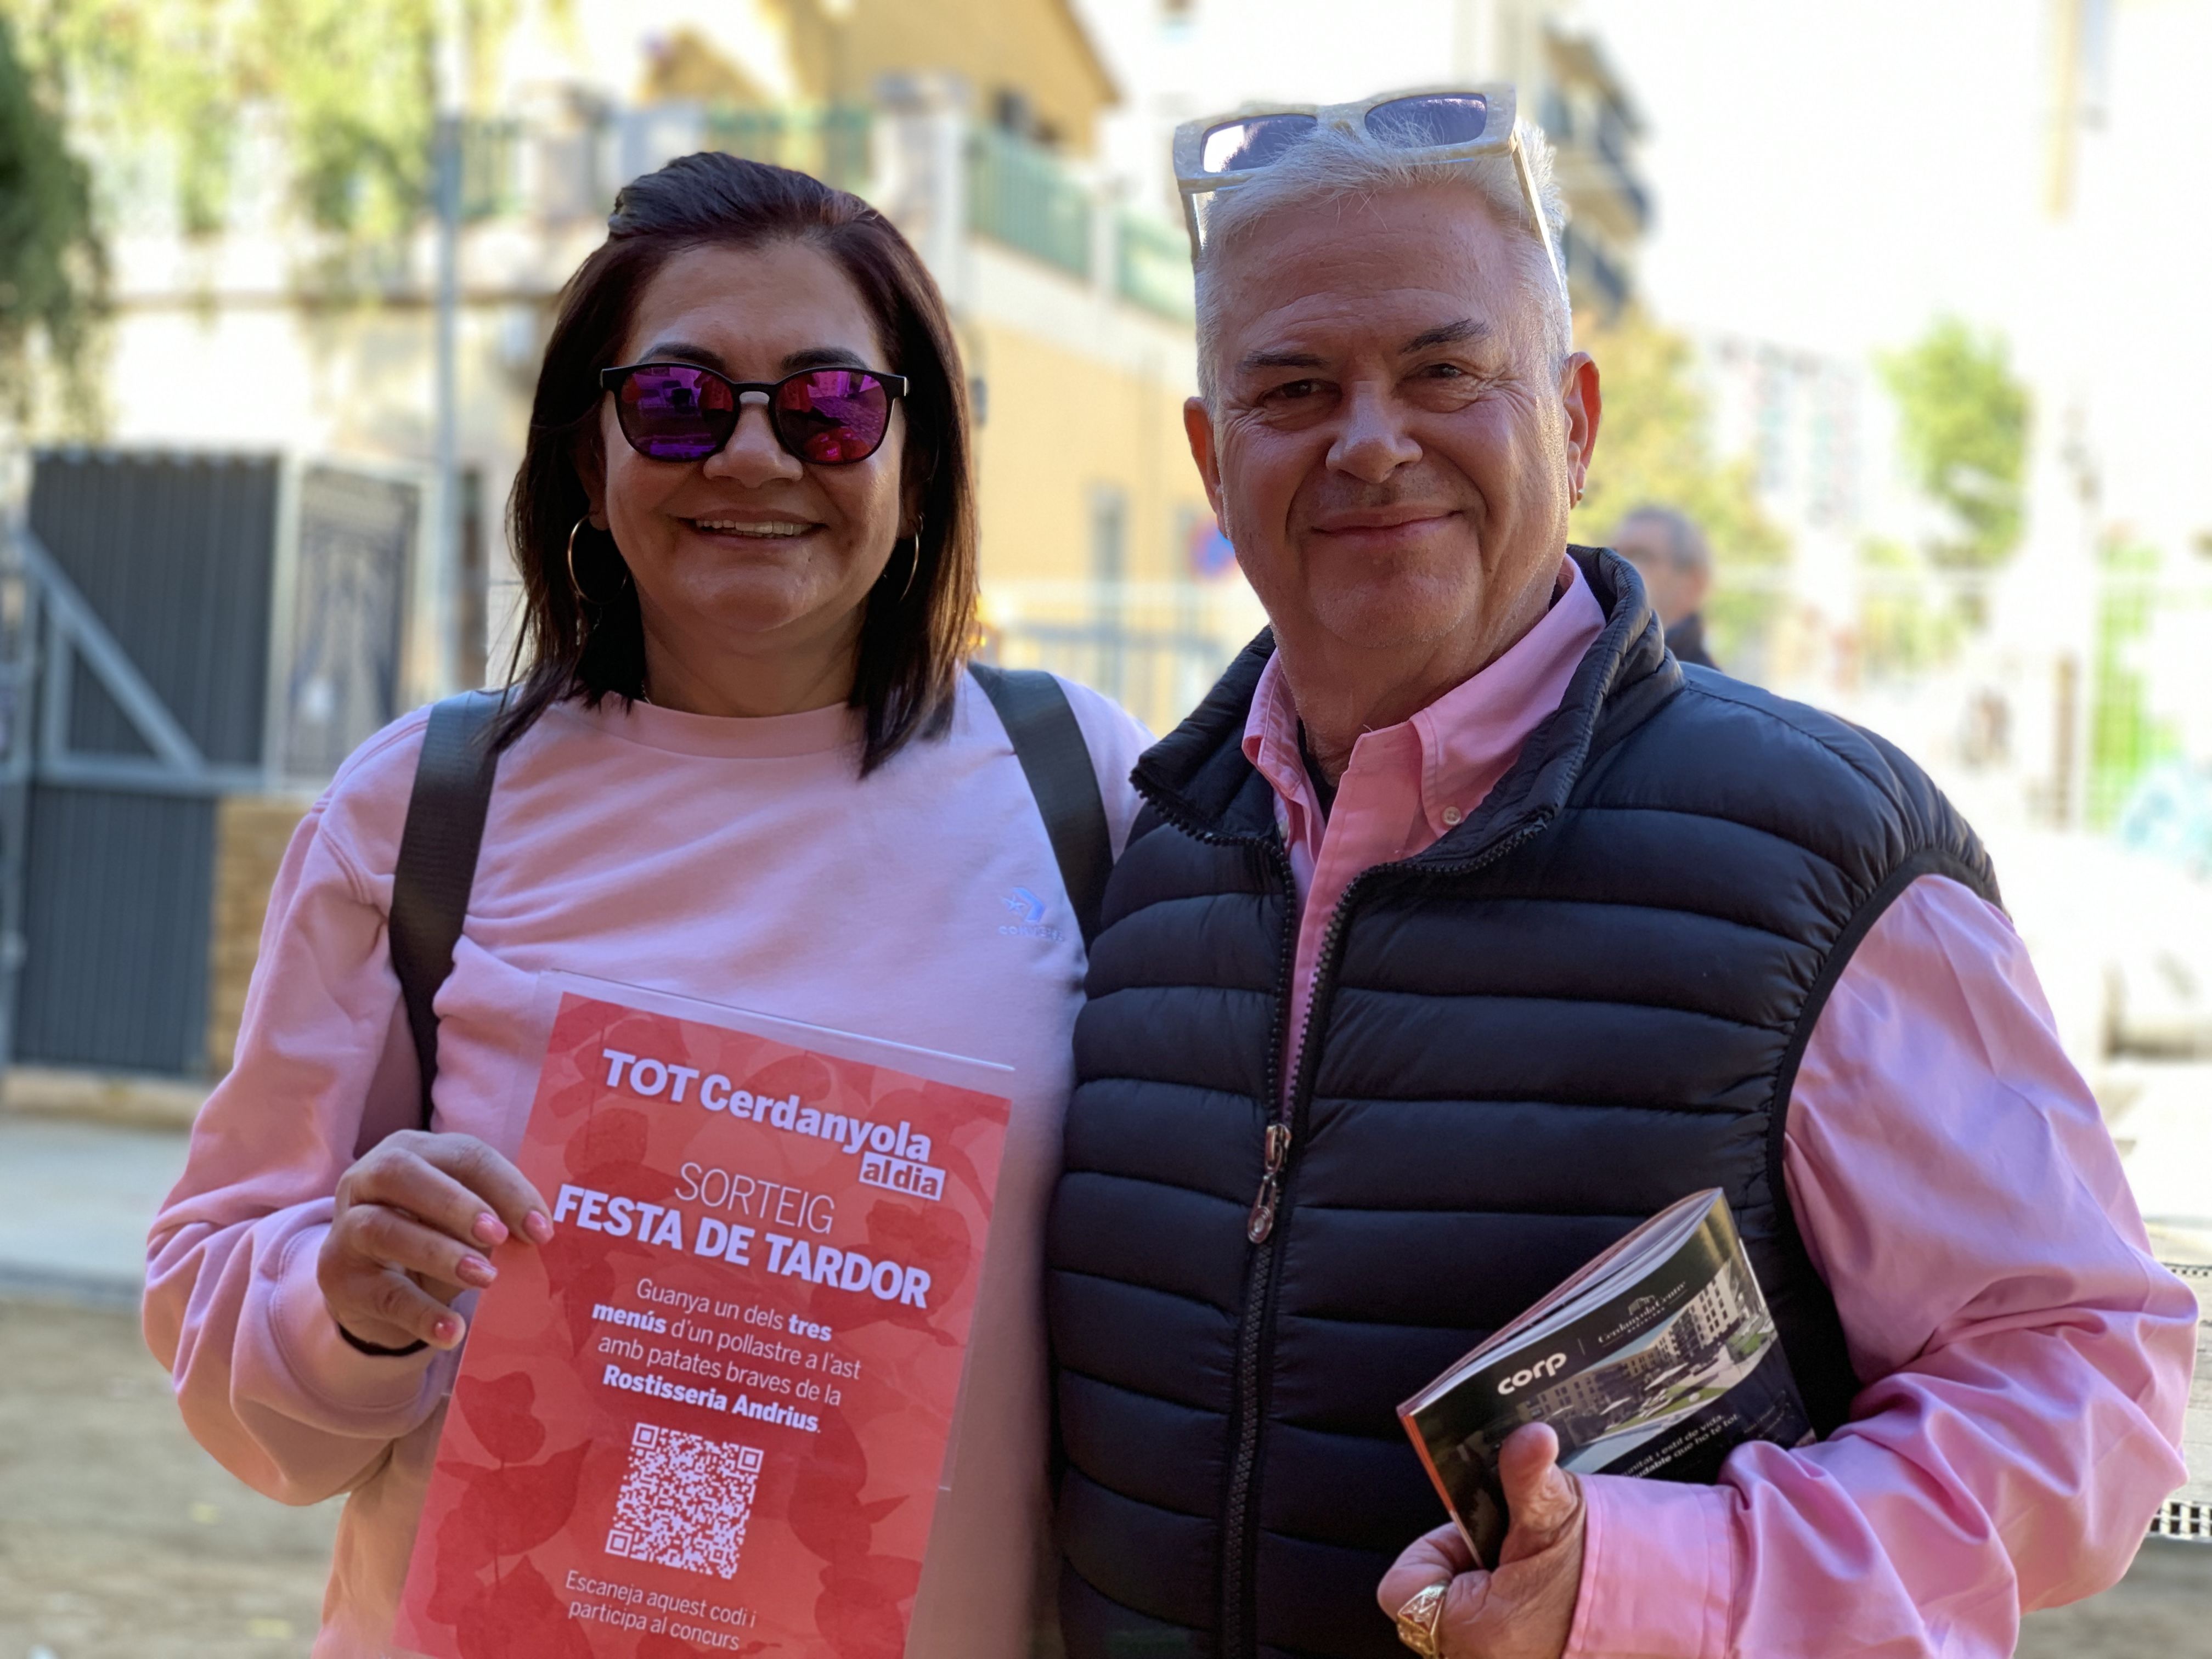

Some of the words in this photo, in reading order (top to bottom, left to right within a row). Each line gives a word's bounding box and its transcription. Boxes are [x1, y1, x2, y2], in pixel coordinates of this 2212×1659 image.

[603, 1049, 699, 1101] TOT
[701, 1075, 931, 1163] Cerdanyola
[675, 1162, 833, 1234] SORTEIG
[554, 1184, 682, 1250] FESTA
[695, 1218, 754, 1265] DE
[766, 1233, 930, 1308] TARDOR
[592, 1304, 666, 1333] menús
[718, 1334, 800, 1364] pollastre
[806, 1355, 817, 1368] a
[638, 1279, 709, 1313] Guanya
[715, 1302, 738, 1319] un
[744, 1306, 783, 1329] dels
[789, 1314, 831, 1341] tres
[599, 1337, 642, 1359] amb
[647, 1349, 721, 1377] patates
[726, 1362, 790, 1393] braves
[797, 1380, 819, 1400] de
[825, 1385, 840, 1405] la
[603, 1365, 727, 1410] Rostisseria
[732, 1395, 820, 1432] Andrius.
[1498, 1352, 1567, 1395] corp
[1622, 1455, 1654, 1476] unitat
[1661, 1437, 1683, 1454] estil
[1685, 1430, 1699, 1441] de
[1673, 1442, 1693, 1457] que
[1695, 1434, 1709, 1444] ho
[566, 1571, 642, 1604] Escaneja
[648, 1593, 706, 1616] aquest
[710, 1607, 747, 1625] codi
[751, 1610, 756, 1628] i
[569, 1601, 647, 1630] participa
[651, 1618, 667, 1633] al
[670, 1623, 739, 1649] concurs
